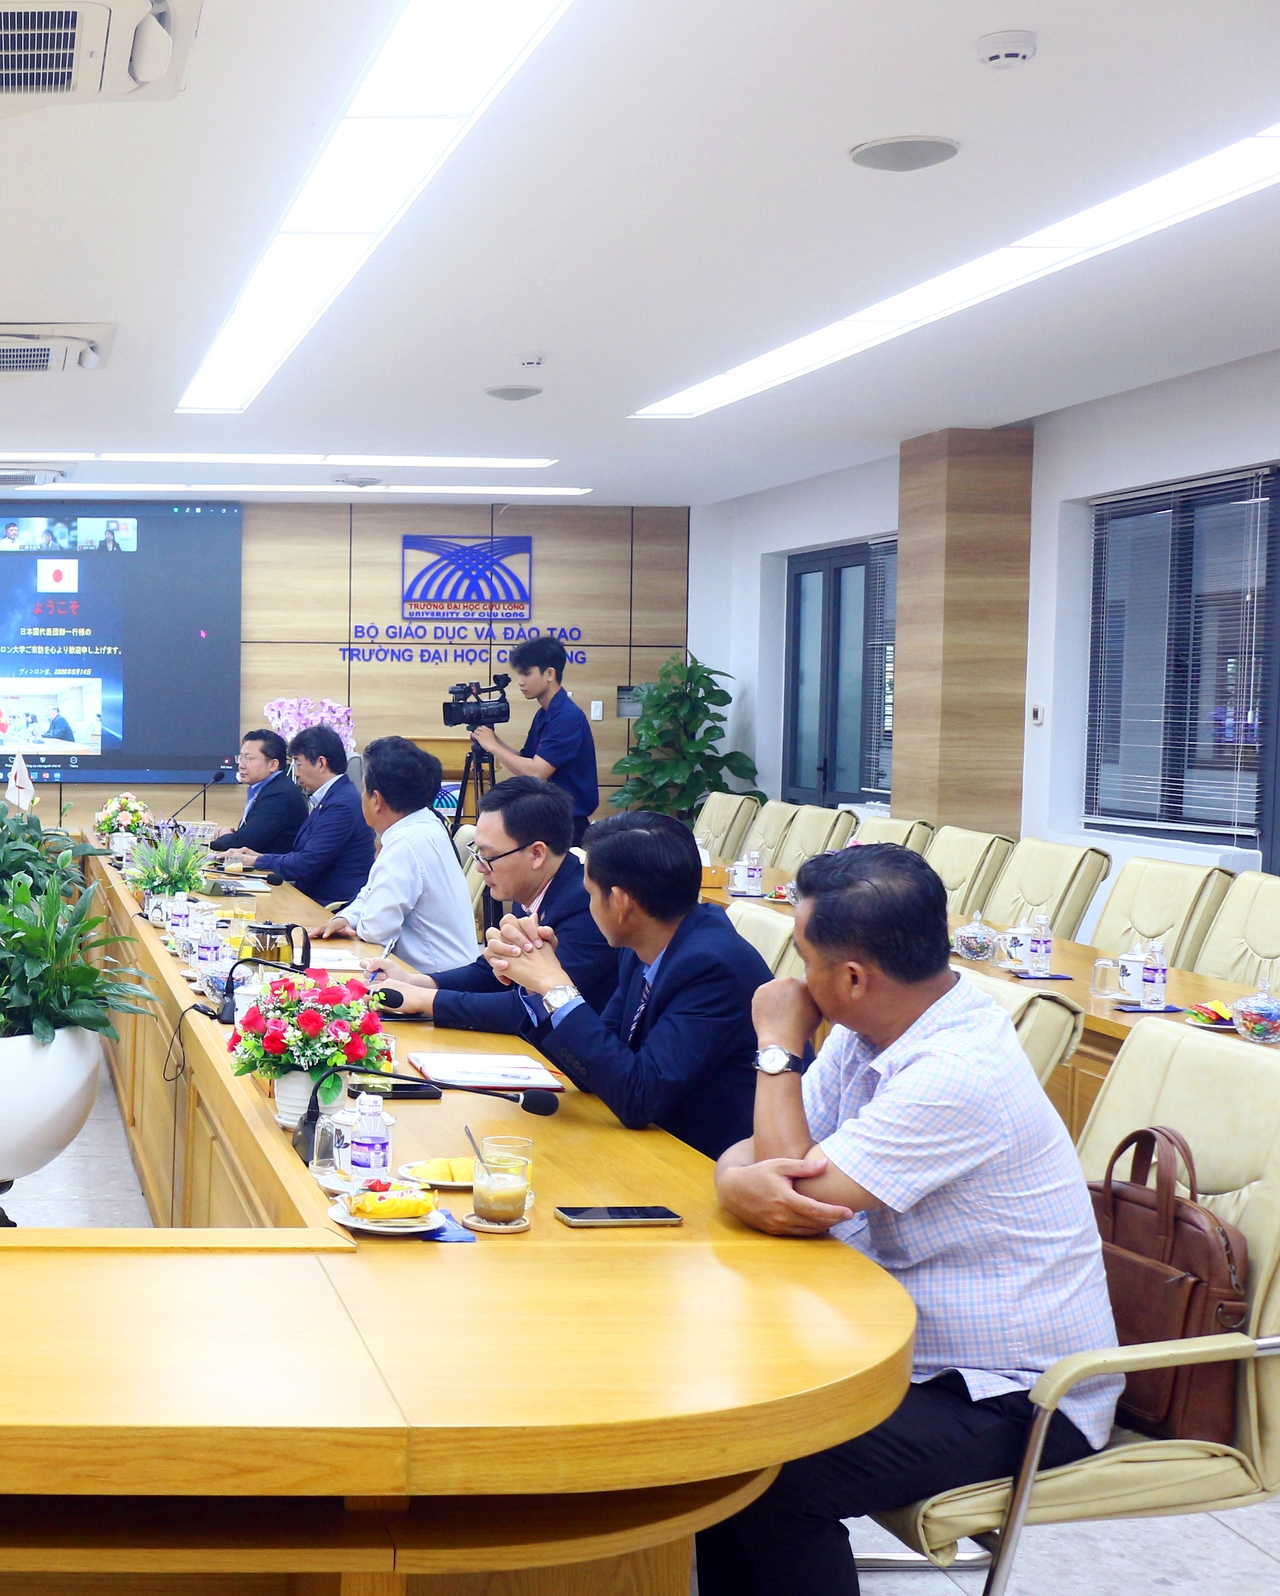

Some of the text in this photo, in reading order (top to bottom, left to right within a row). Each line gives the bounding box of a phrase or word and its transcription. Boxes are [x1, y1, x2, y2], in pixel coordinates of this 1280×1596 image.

[33, 600, 80, 615] ようこそ
[354, 622, 379, 643] BỘ
[385, 621, 427, 640] GIÁO
[434, 626, 468, 644] DỤC
[474, 622, 496, 641] VÀ
[503, 623, 540, 640] ĐÀO
[339, 645, 413, 663] TRƯỜNG
[419, 648, 448, 666] ĐẠI
[453, 649, 489, 666] HỌC
